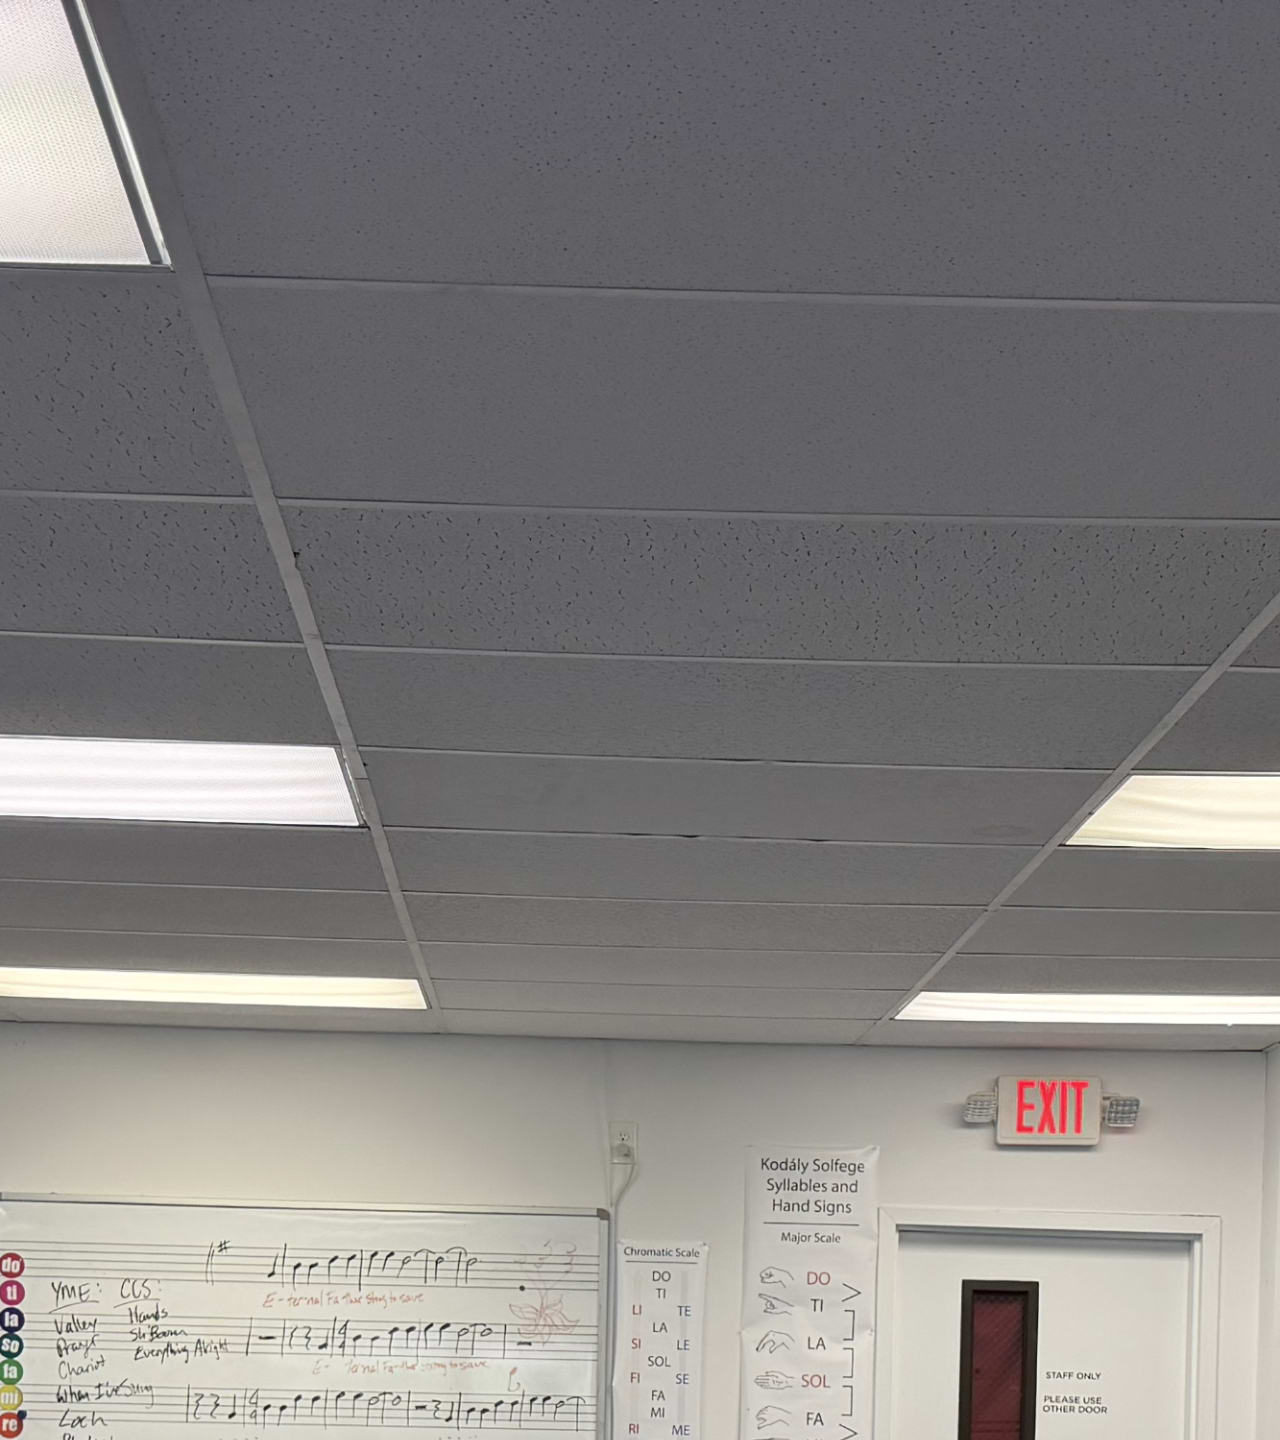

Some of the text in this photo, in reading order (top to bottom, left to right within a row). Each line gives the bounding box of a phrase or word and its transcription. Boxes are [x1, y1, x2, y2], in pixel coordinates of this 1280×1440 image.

[1016, 1080, 1089, 1134] EXIT
[761, 1157, 864, 1175] Kodály Solfege
[766, 1178, 858, 1194] Syllables and
[772, 1199, 852, 1216] Hand Signs
[781, 1232, 841, 1244] Major Scale
[624, 1246, 700, 1257] Chromatic Scale
[652, 1270, 671, 1282] DO
[807, 1272, 831, 1285] DO
[6, 1285, 17, 1300] ti
[656, 1288, 666, 1299] TI
[632, 1304, 691, 1316] LI TE
[810, 1299, 823, 1312] TI
[4, 1312, 18, 1327] la
[54, 1314, 97, 1335] Valley
[652, 1322, 668, 1333] LA
[1, 1338, 20, 1353] so
[631, 1338, 690, 1351] SI LE
[808, 1336, 826, 1350] LA
[648, 1356, 671, 1367] SOL
[3, 1363, 17, 1378] fa
[1046, 1371, 1101, 1380] STAFF ONLY
[630, 1372, 689, 1385] FI SE
[801, 1374, 830, 1388] SOL
[651, 1390, 665, 1401] FA
[1044, 1395, 1080, 1403] PLEASE
[651, 1407, 665, 1418] MI
[1043, 1405, 1075, 1413] OTHER
[2, 1418, 17, 1432] re
[806, 1412, 824, 1426] FA
[629, 1424, 690, 1436] RI ME
